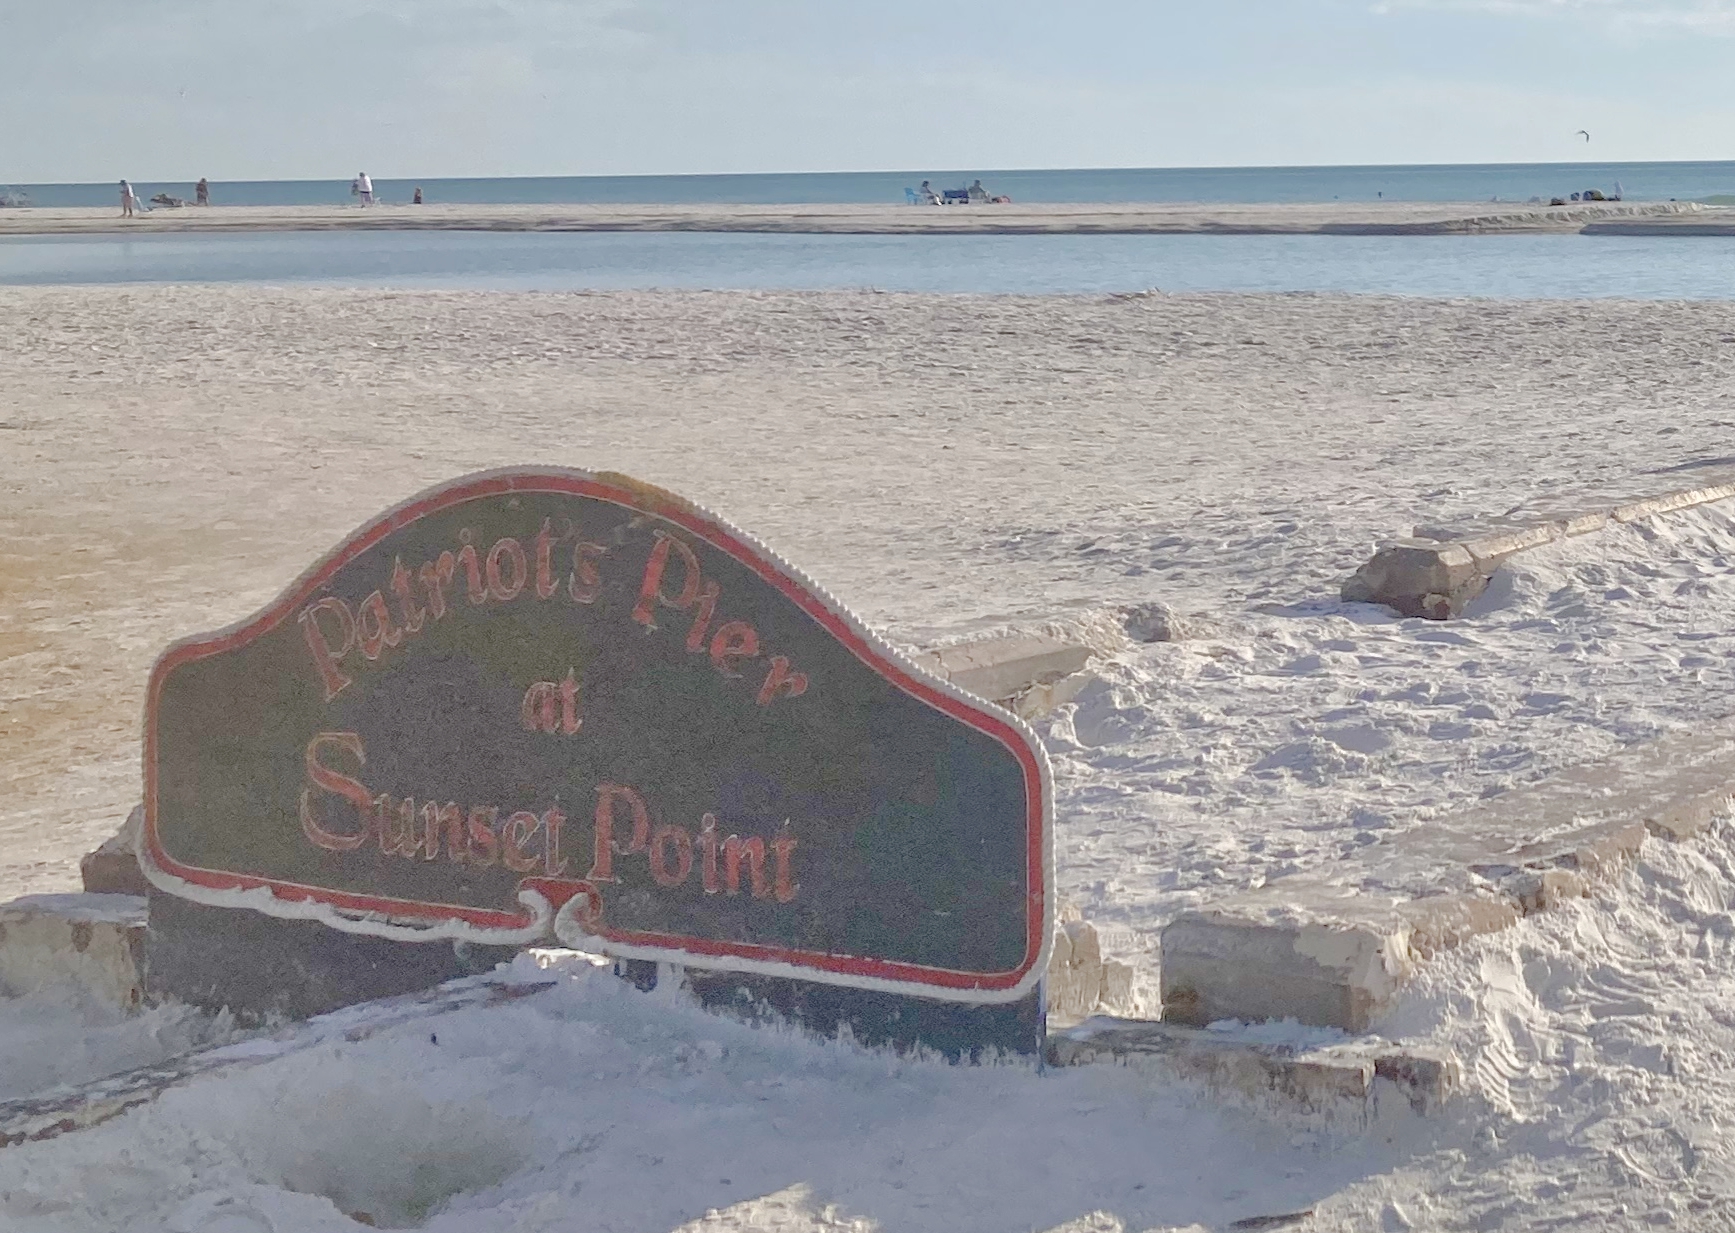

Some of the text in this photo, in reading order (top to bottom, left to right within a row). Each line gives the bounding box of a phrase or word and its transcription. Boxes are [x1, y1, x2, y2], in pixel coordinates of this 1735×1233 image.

[298, 516, 808, 706] Patriot's Pier
[521, 667, 584, 735] at
[301, 732, 798, 903] Sunset Point
